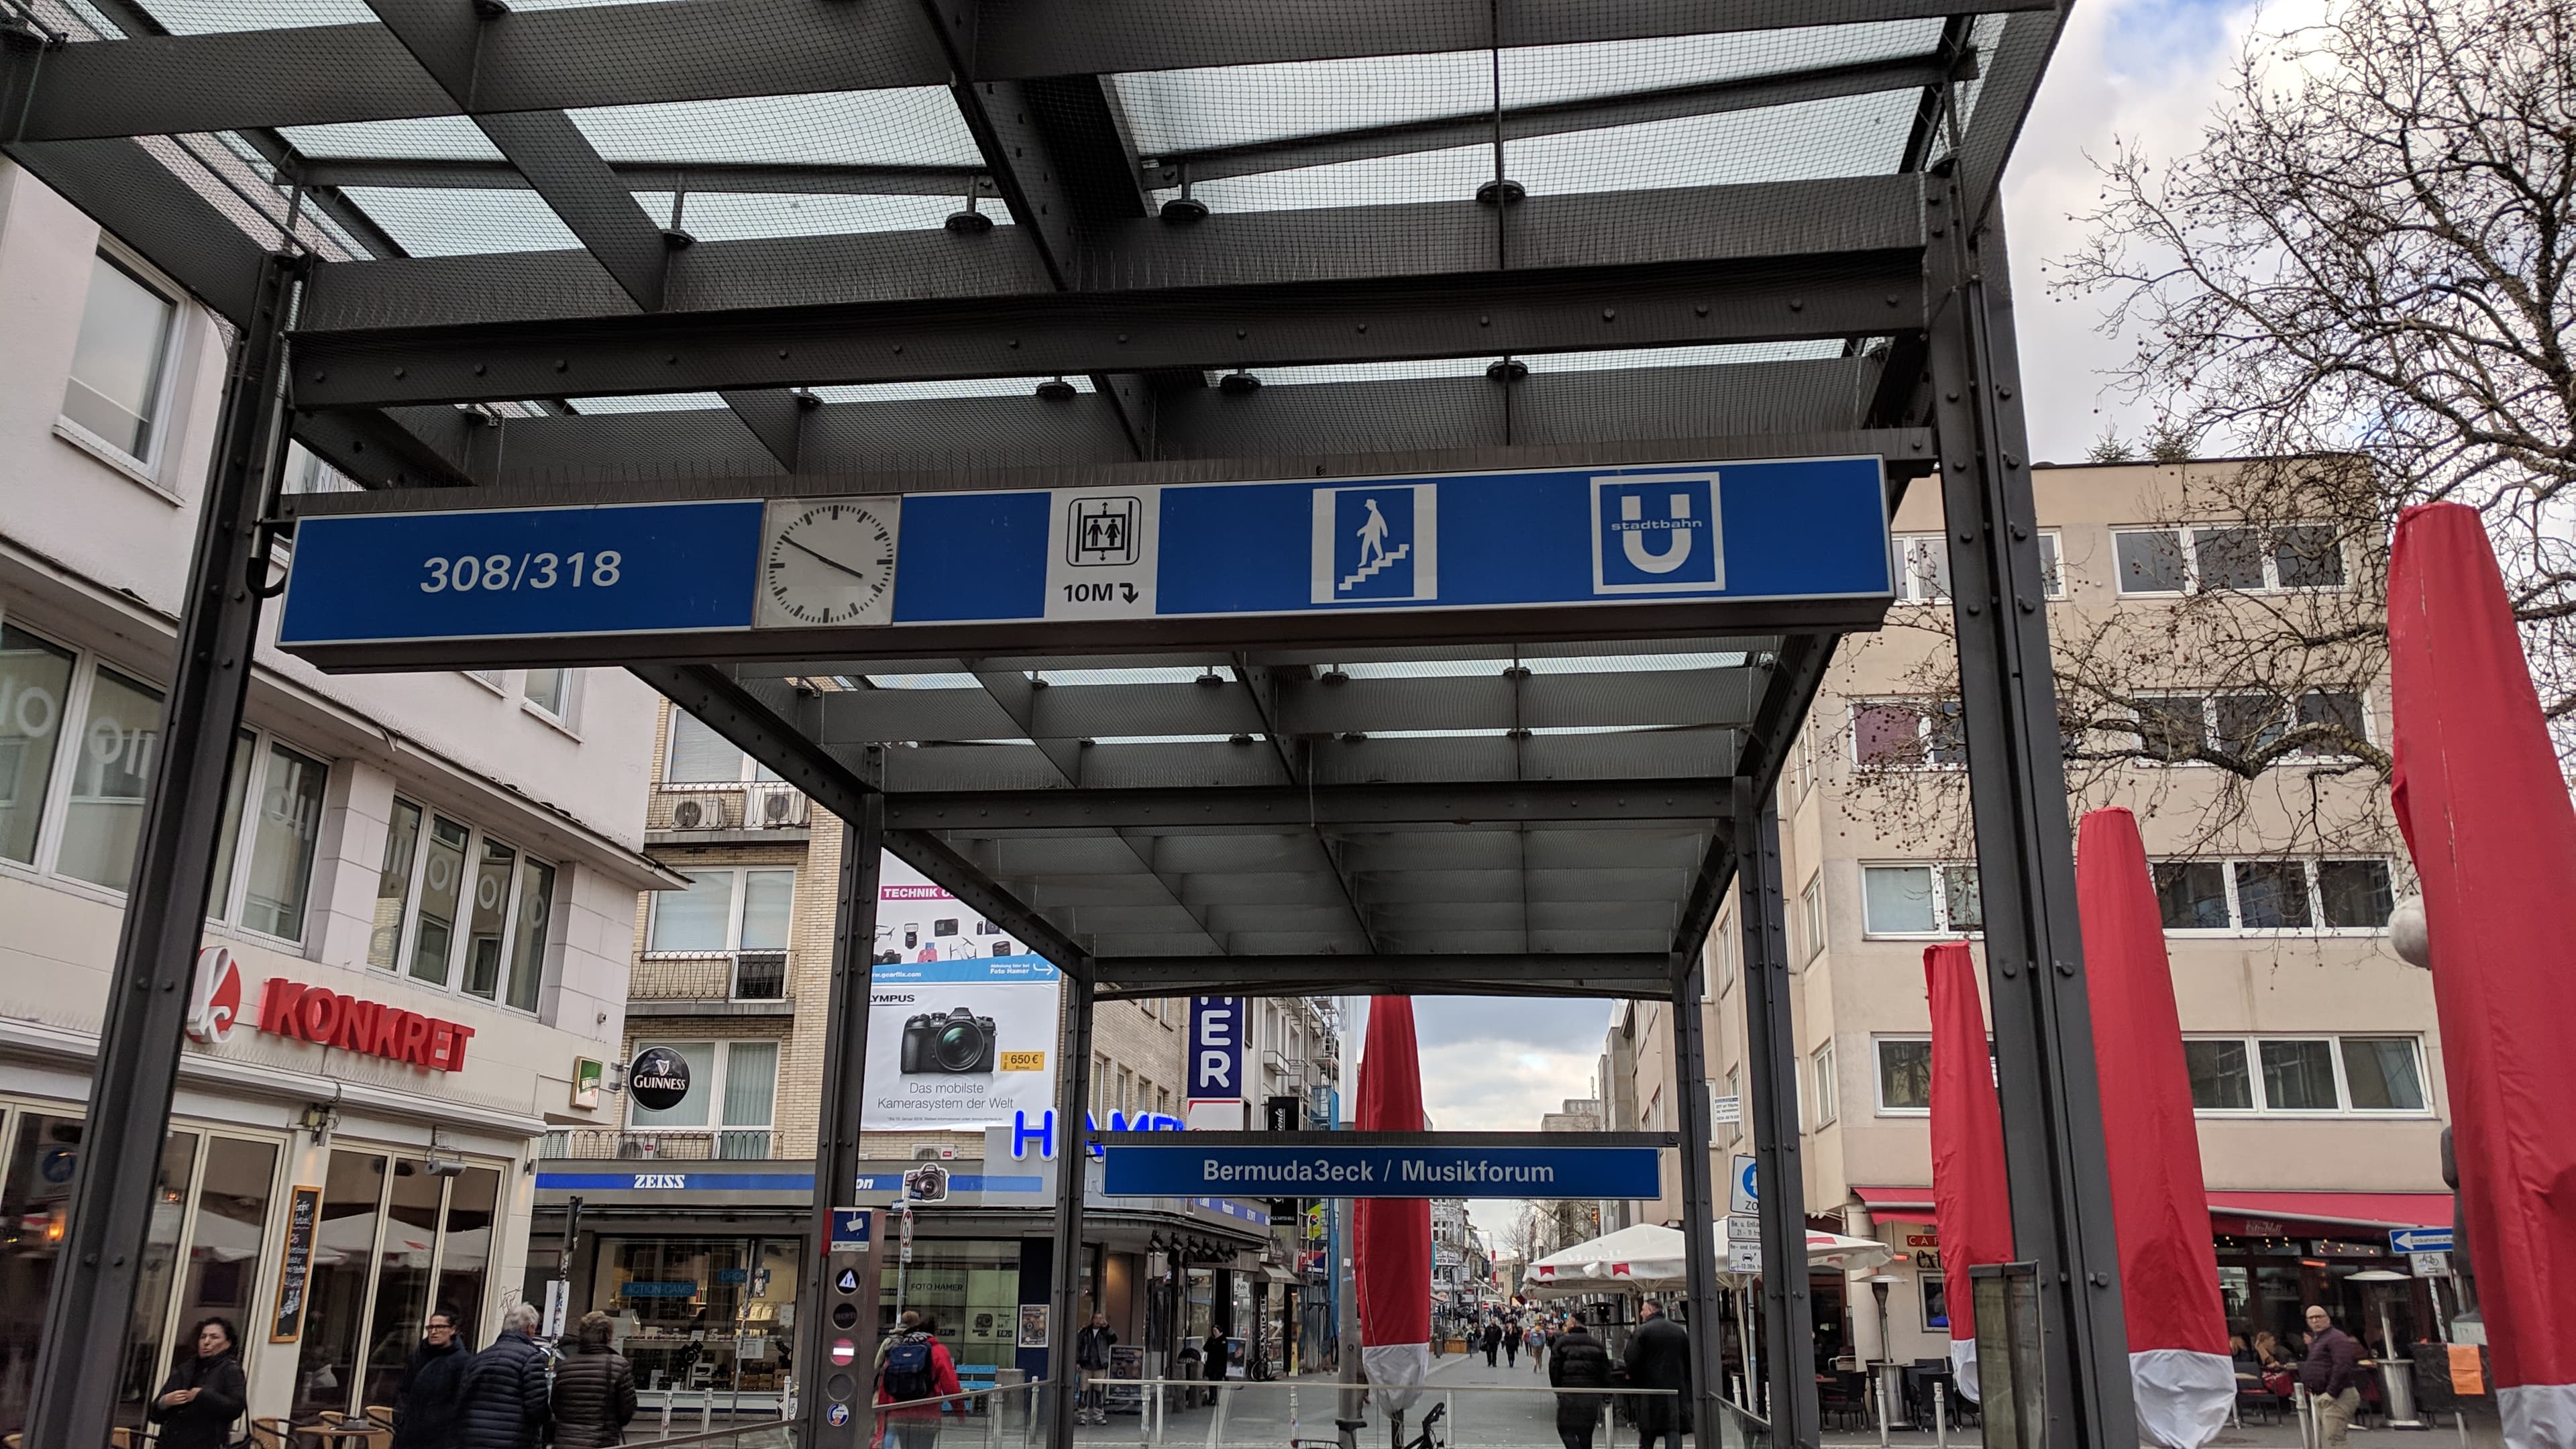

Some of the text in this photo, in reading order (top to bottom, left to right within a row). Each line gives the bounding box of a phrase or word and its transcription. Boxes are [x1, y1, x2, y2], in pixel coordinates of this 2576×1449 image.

[1611, 519, 1702, 531] stadtbahn
[420, 550, 622, 593] 308/318
[1063, 583, 1113, 602] 10M
[883, 888, 937, 898] TECHNIK
[870, 994, 915, 1003] YMPUS
[259, 978, 476, 1073] KONKRET
[1200, 997, 1232, 1088] ER
[1011, 1055, 1030, 1064] 650
[633, 1075, 686, 1091] GUINNESS
[910, 1082, 983, 1093] Das mobilste
[877, 1097, 1014, 1111] Kamerasystem der Welt
[1203, 1159, 1374, 1182] Bermuda3eck
[1401, 1159, 1554, 1182] Musikforum
[633, 1174, 686, 1189] ZEISS
[1745, 1201, 1759, 1210] ZO
[627, 1284, 692, 1294] ACTION-CAMS
[934, 1283, 963, 1291] HAMER
